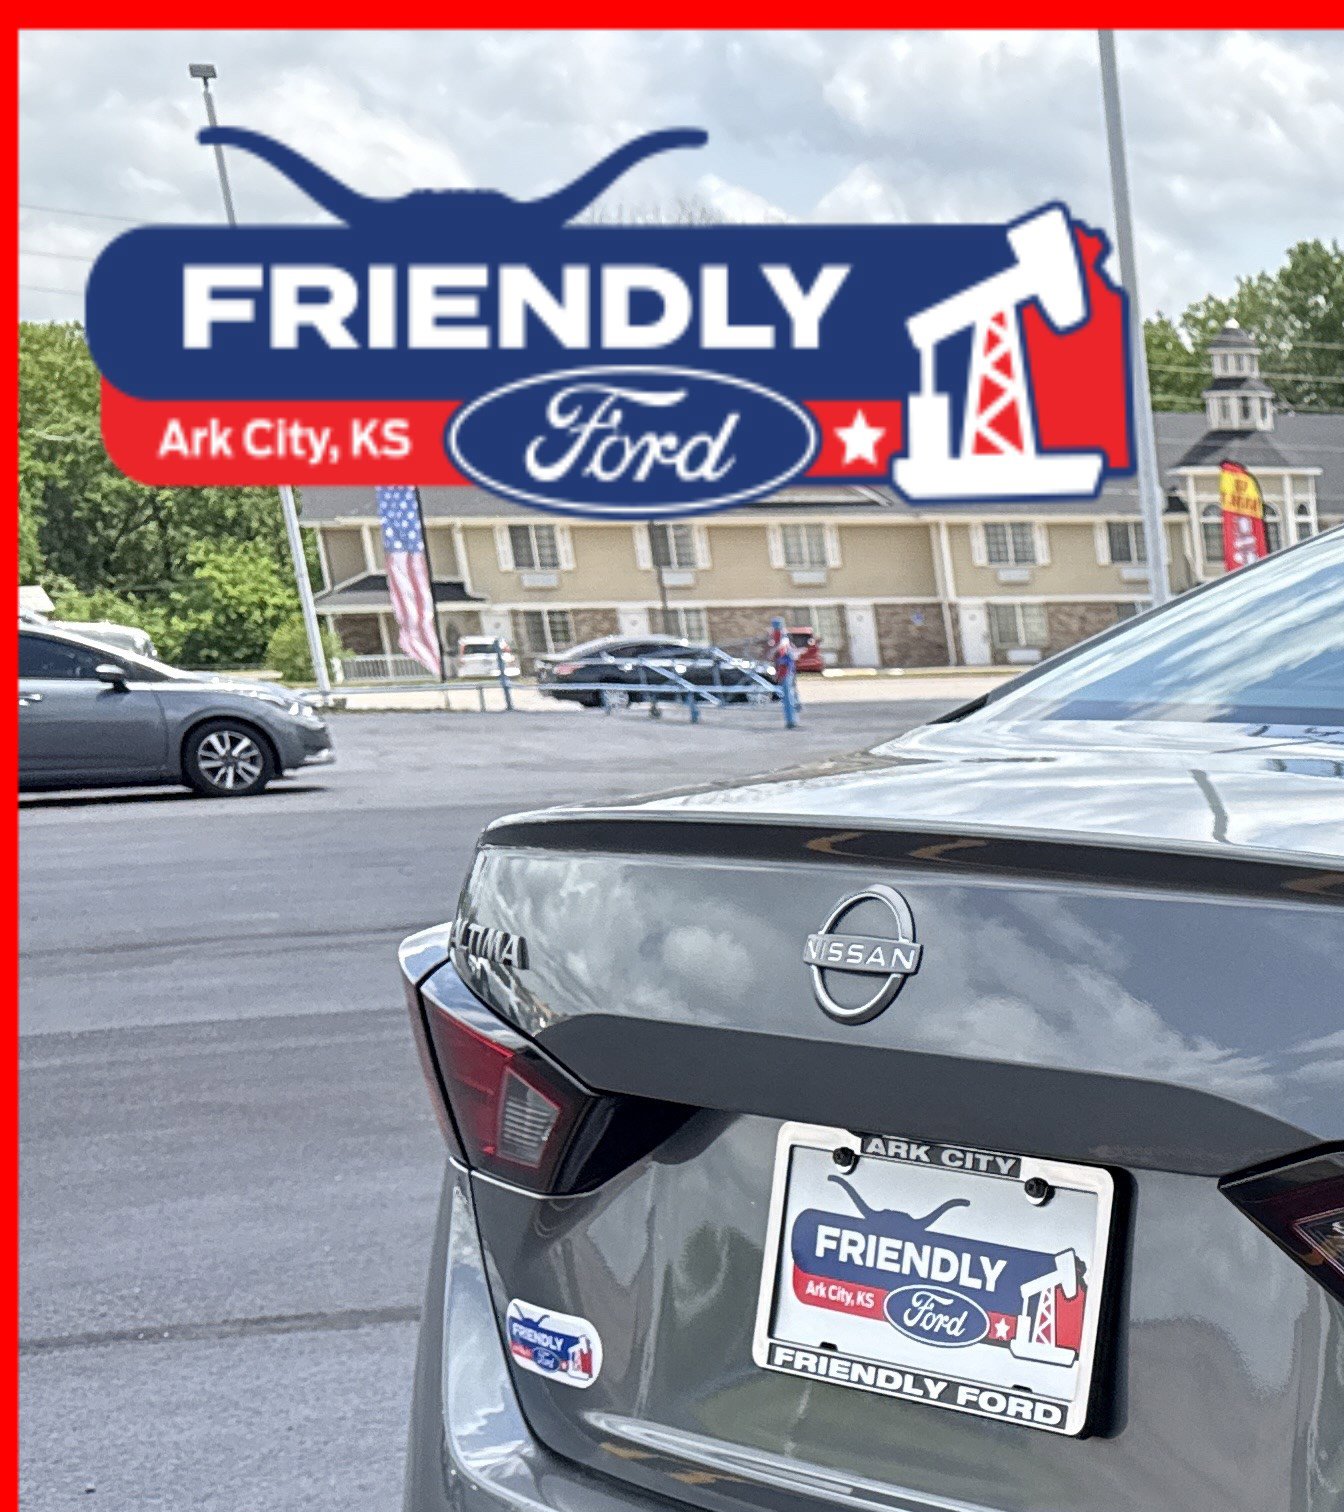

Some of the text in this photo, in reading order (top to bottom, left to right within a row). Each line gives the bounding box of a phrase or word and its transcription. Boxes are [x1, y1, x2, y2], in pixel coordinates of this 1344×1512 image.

[807, 939, 916, 970] NISSAN
[864, 1137, 1018, 1176] ARK CITY
[815, 1224, 1008, 1293] FRIENDLY
[804, 1280, 876, 1310] Ark City, KS
[903, 1290, 966, 1338] Ford
[771, 1347, 1063, 1427] FRIENDLY FORD
